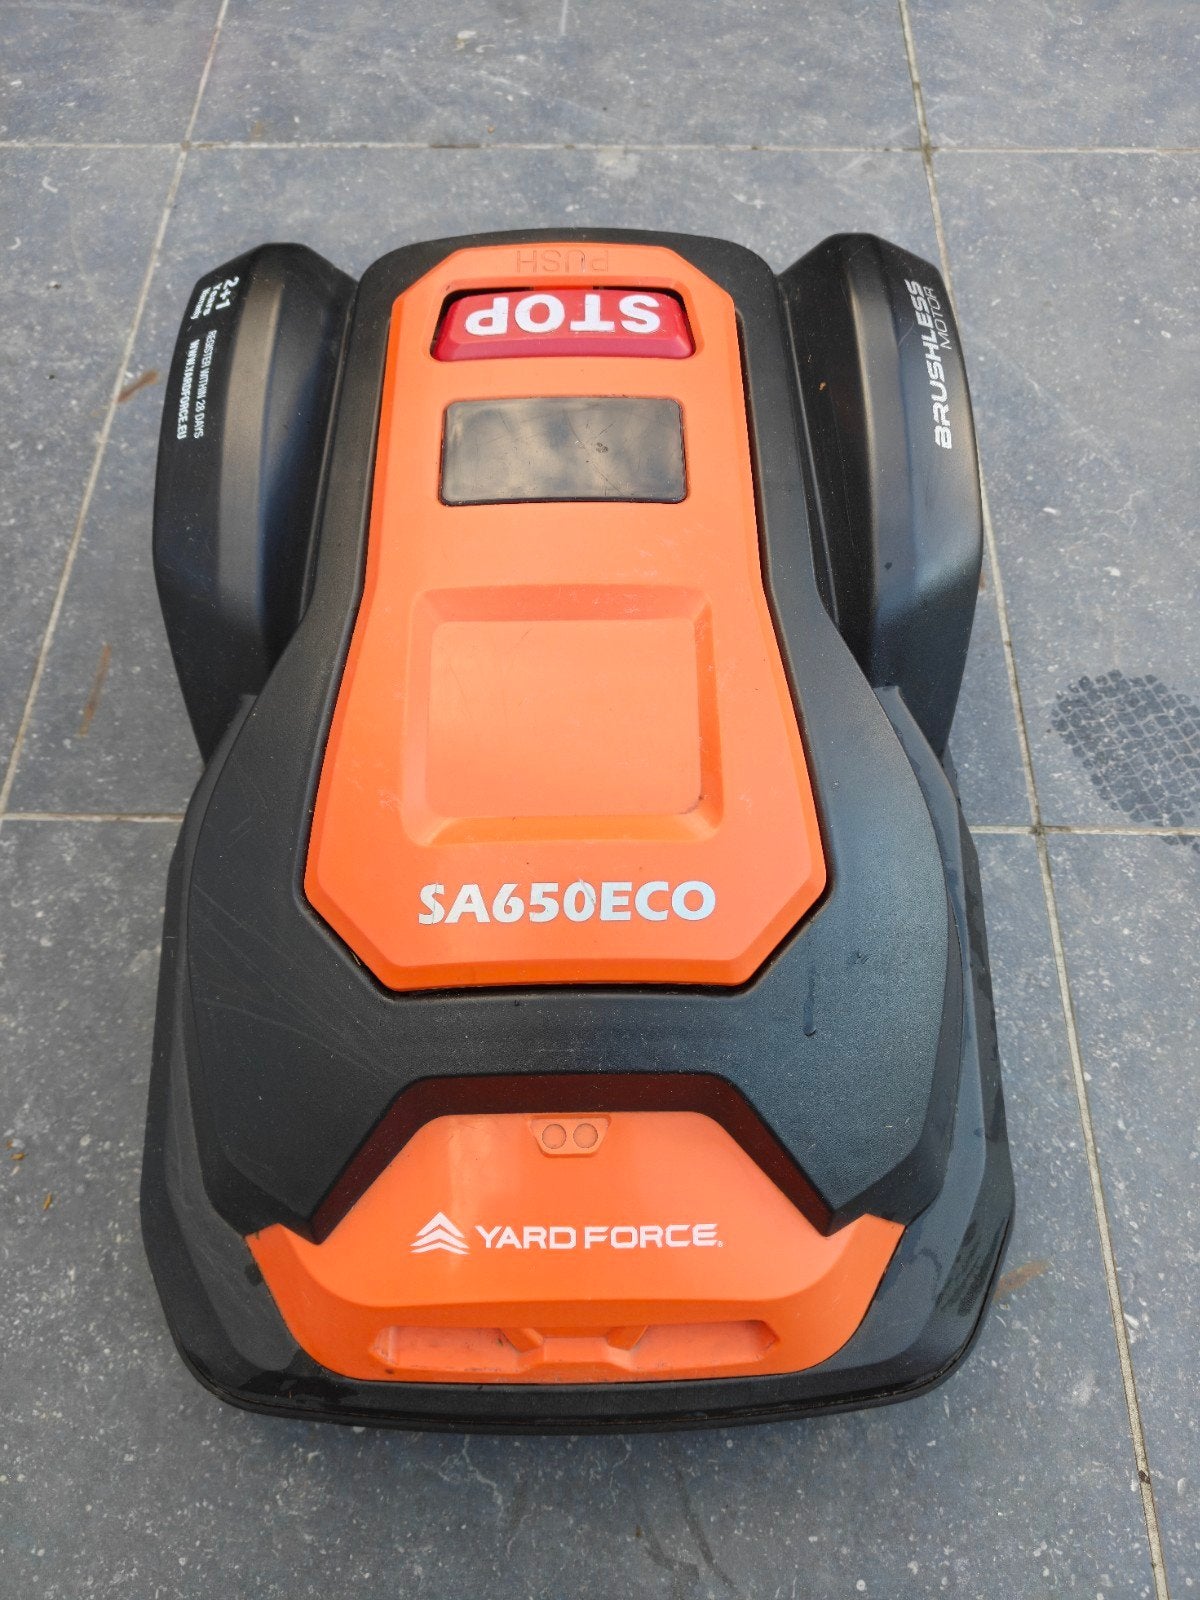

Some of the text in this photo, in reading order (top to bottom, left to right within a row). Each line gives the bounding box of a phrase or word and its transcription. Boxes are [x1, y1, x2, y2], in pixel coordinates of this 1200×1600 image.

[516, 249, 609, 273] PUSH
[215, 276, 240, 310] 2+1
[465, 294, 661, 336] STOP
[923, 286, 952, 350] MOTOR
[193, 330, 217, 439] REGISTER WITHIN 28 DAYS
[904, 279, 953, 450] BRUSHLESS
[176, 339, 200, 440] WWW.YARDFORCE.EU
[418, 879, 716, 925] SA650ECO
[475, 1225, 577, 1249] YARD
